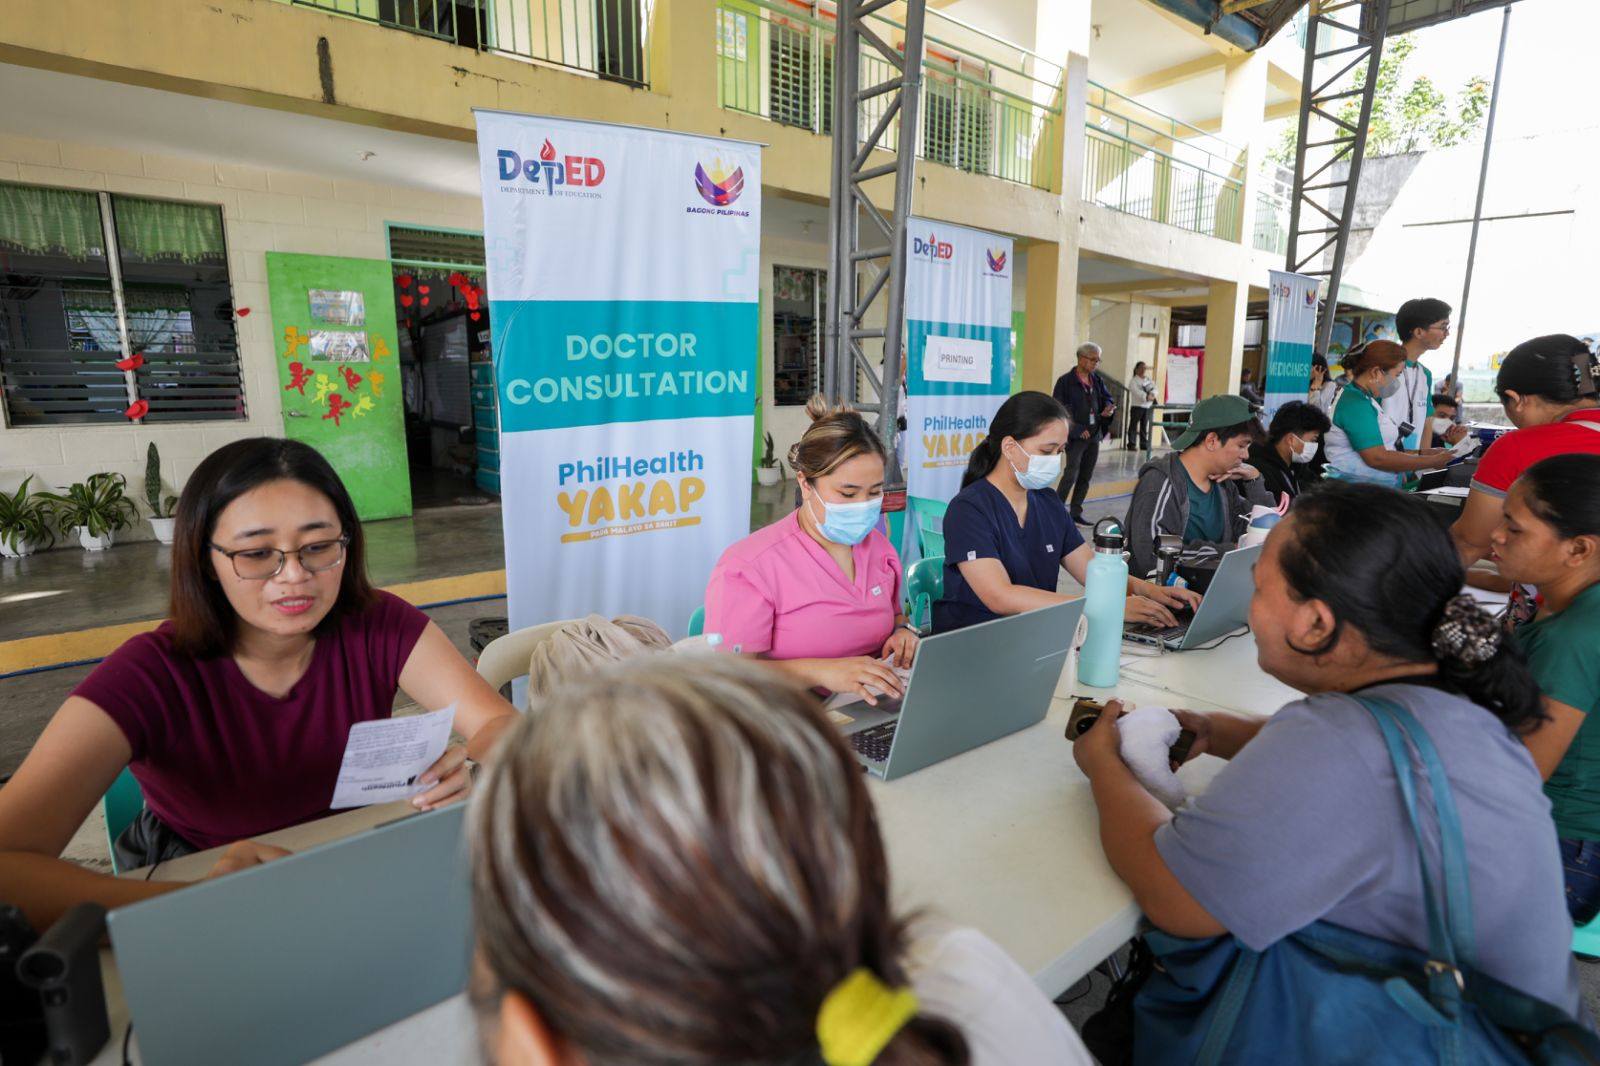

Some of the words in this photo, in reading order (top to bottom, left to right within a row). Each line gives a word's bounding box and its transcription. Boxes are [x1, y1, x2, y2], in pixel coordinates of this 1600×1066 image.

[497, 147, 605, 195] DepED
[501, 186, 545, 196] DEPARTMENT
[717, 209, 749, 217] PILIPINAS
[914, 237, 953, 262] DepED
[566, 333, 697, 361] DOCTOR
[940, 354, 974, 365] PRINTING
[1269, 361, 1309, 377] MEDICINES
[506, 370, 748, 405] CONSULTATION
[923, 415, 987, 431] PhilHealth
[558, 450, 704, 485] PhilHealth
[556, 476, 705, 527] YAKAP
